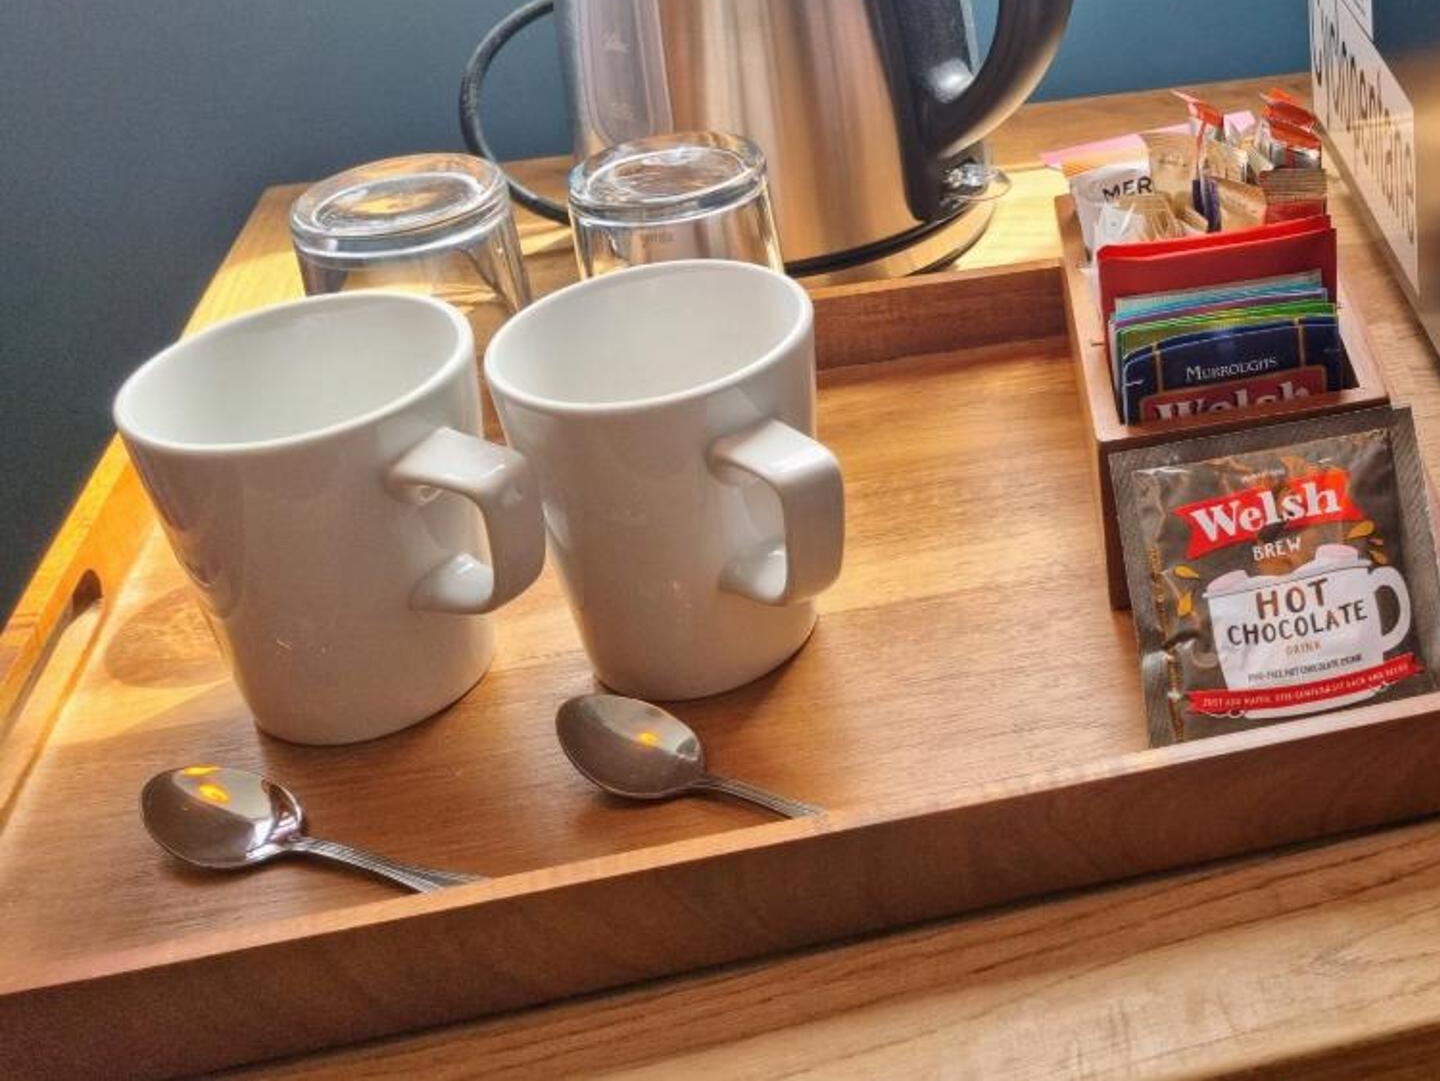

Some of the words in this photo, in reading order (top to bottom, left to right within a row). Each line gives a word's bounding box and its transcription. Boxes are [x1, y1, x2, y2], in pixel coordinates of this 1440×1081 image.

[1191, 482, 1341, 542] Welsh
[1252, 536, 1302, 562] BREW
[1255, 577, 1328, 620] HOT
[1227, 599, 1368, 647] CHOCOLATE
[1286, 640, 1321, 658] DRINK
